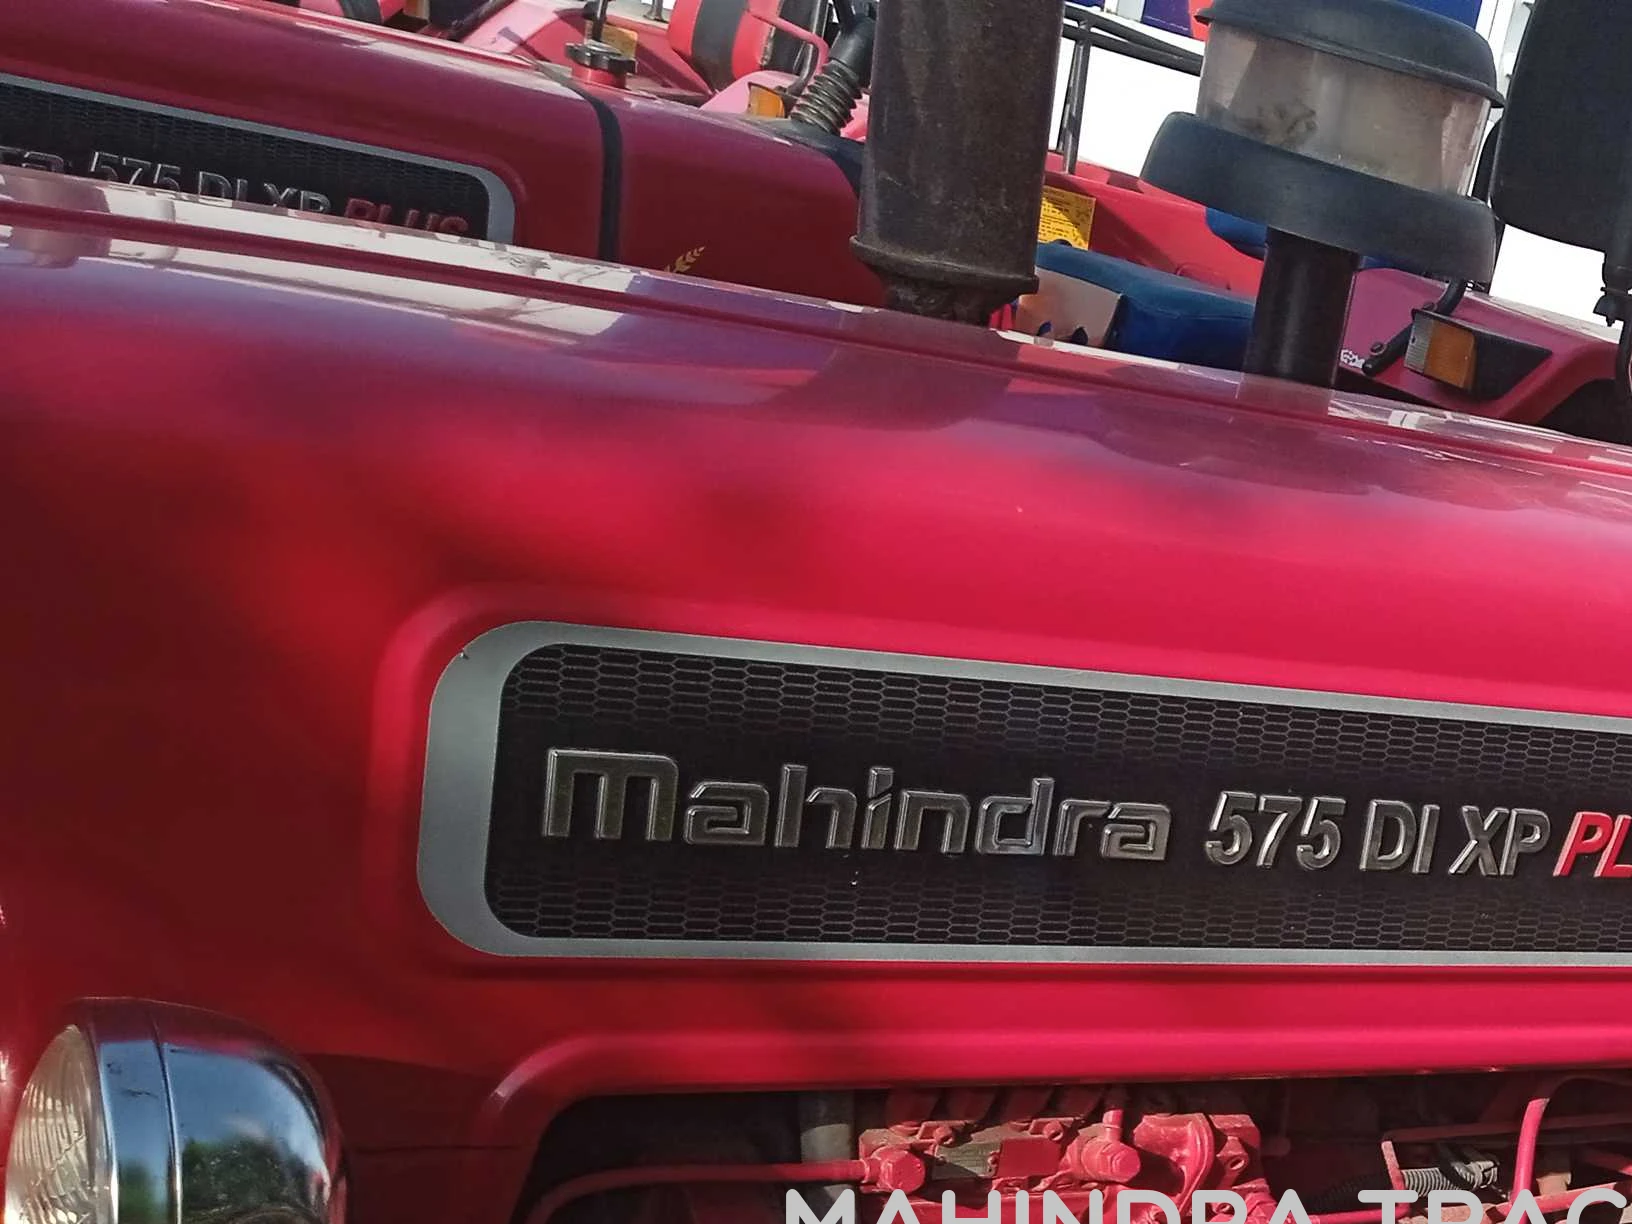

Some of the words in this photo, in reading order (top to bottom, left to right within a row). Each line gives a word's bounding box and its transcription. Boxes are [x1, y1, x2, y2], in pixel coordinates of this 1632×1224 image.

[89, 151, 182, 191] 575
[541, 746, 1172, 862] Mahindra
[1205, 790, 1347, 871] 575
[1359, 798, 1441, 874] DI
[1448, 804, 1552, 877] XP
